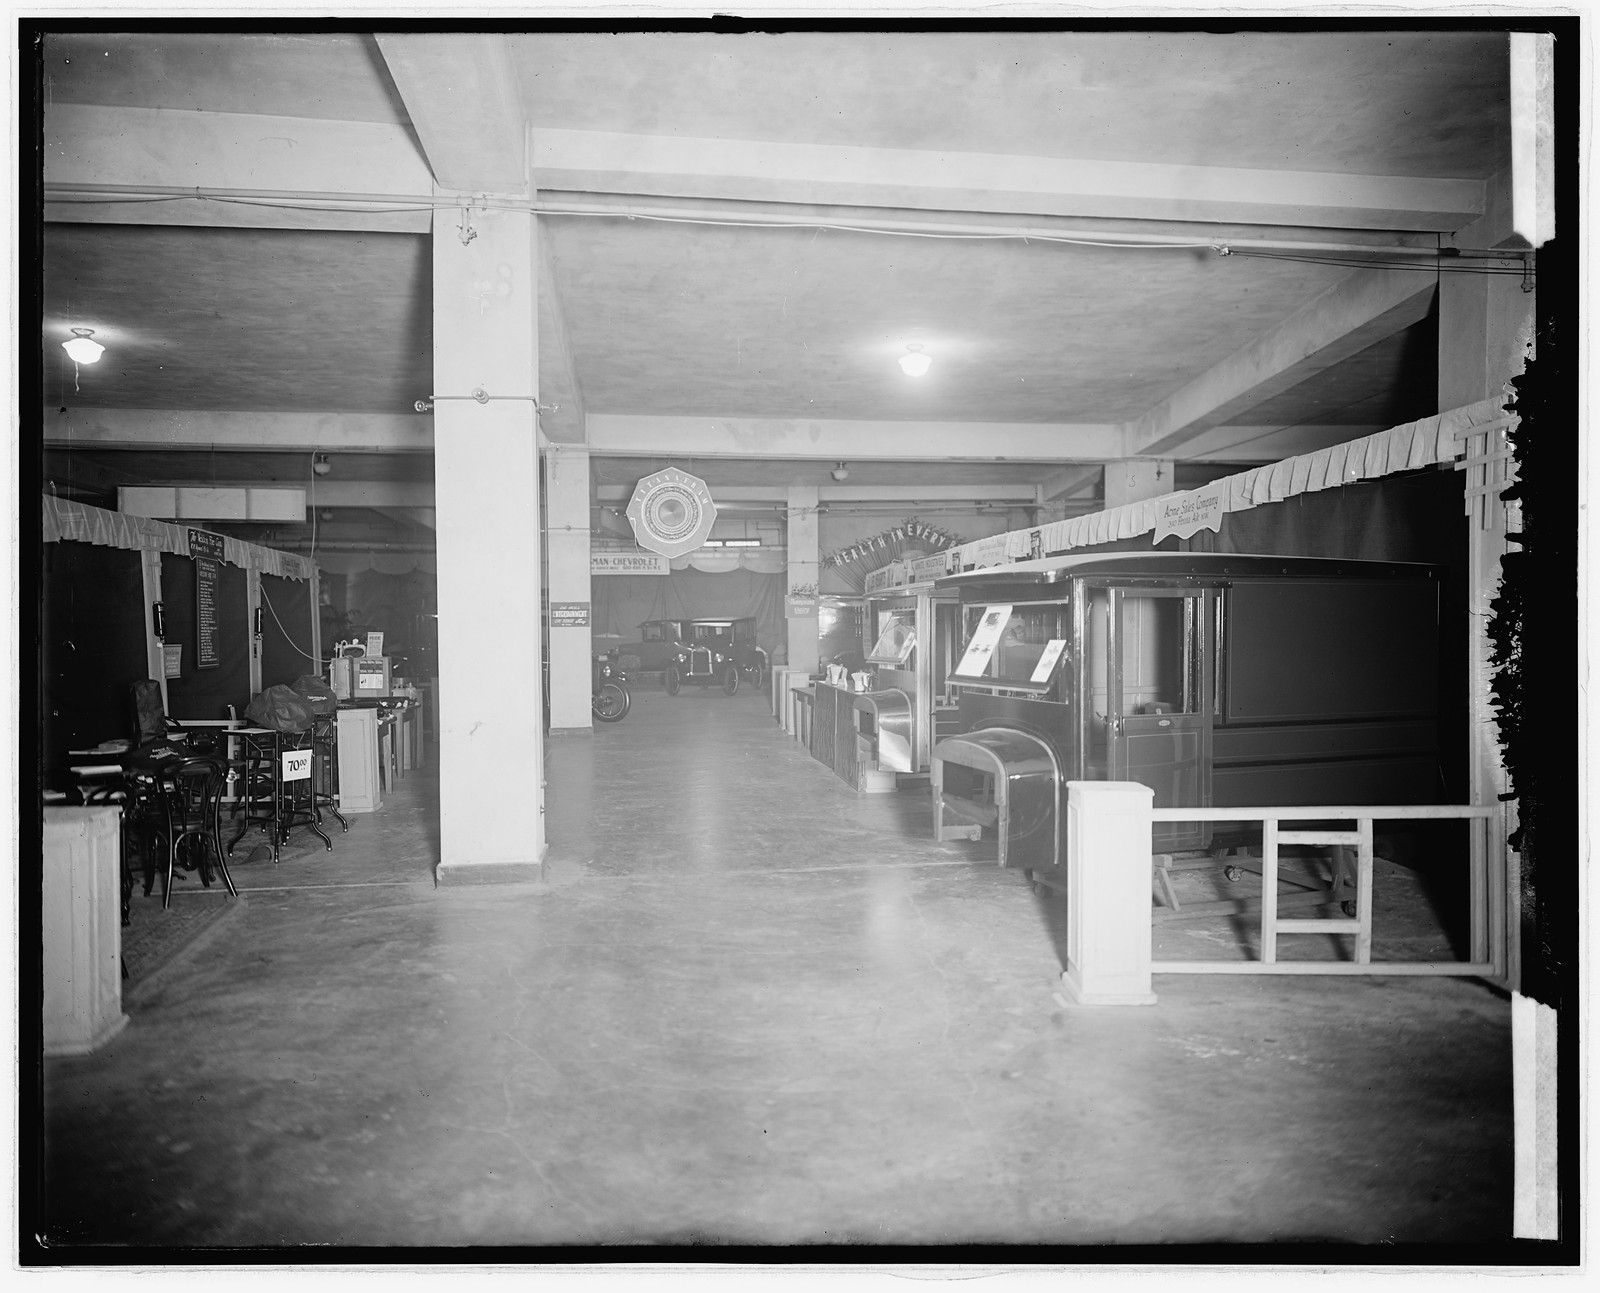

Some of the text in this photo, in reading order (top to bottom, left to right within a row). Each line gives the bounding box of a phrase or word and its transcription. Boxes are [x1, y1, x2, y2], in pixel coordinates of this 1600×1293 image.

[1164, 494, 1219, 518] Acme Sales Company
[833, 536, 886, 567] HEALTH
[891, 528, 905, 543] IN
[907, 524, 946, 547] EVERY
[591, 557, 609, 566] MAN
